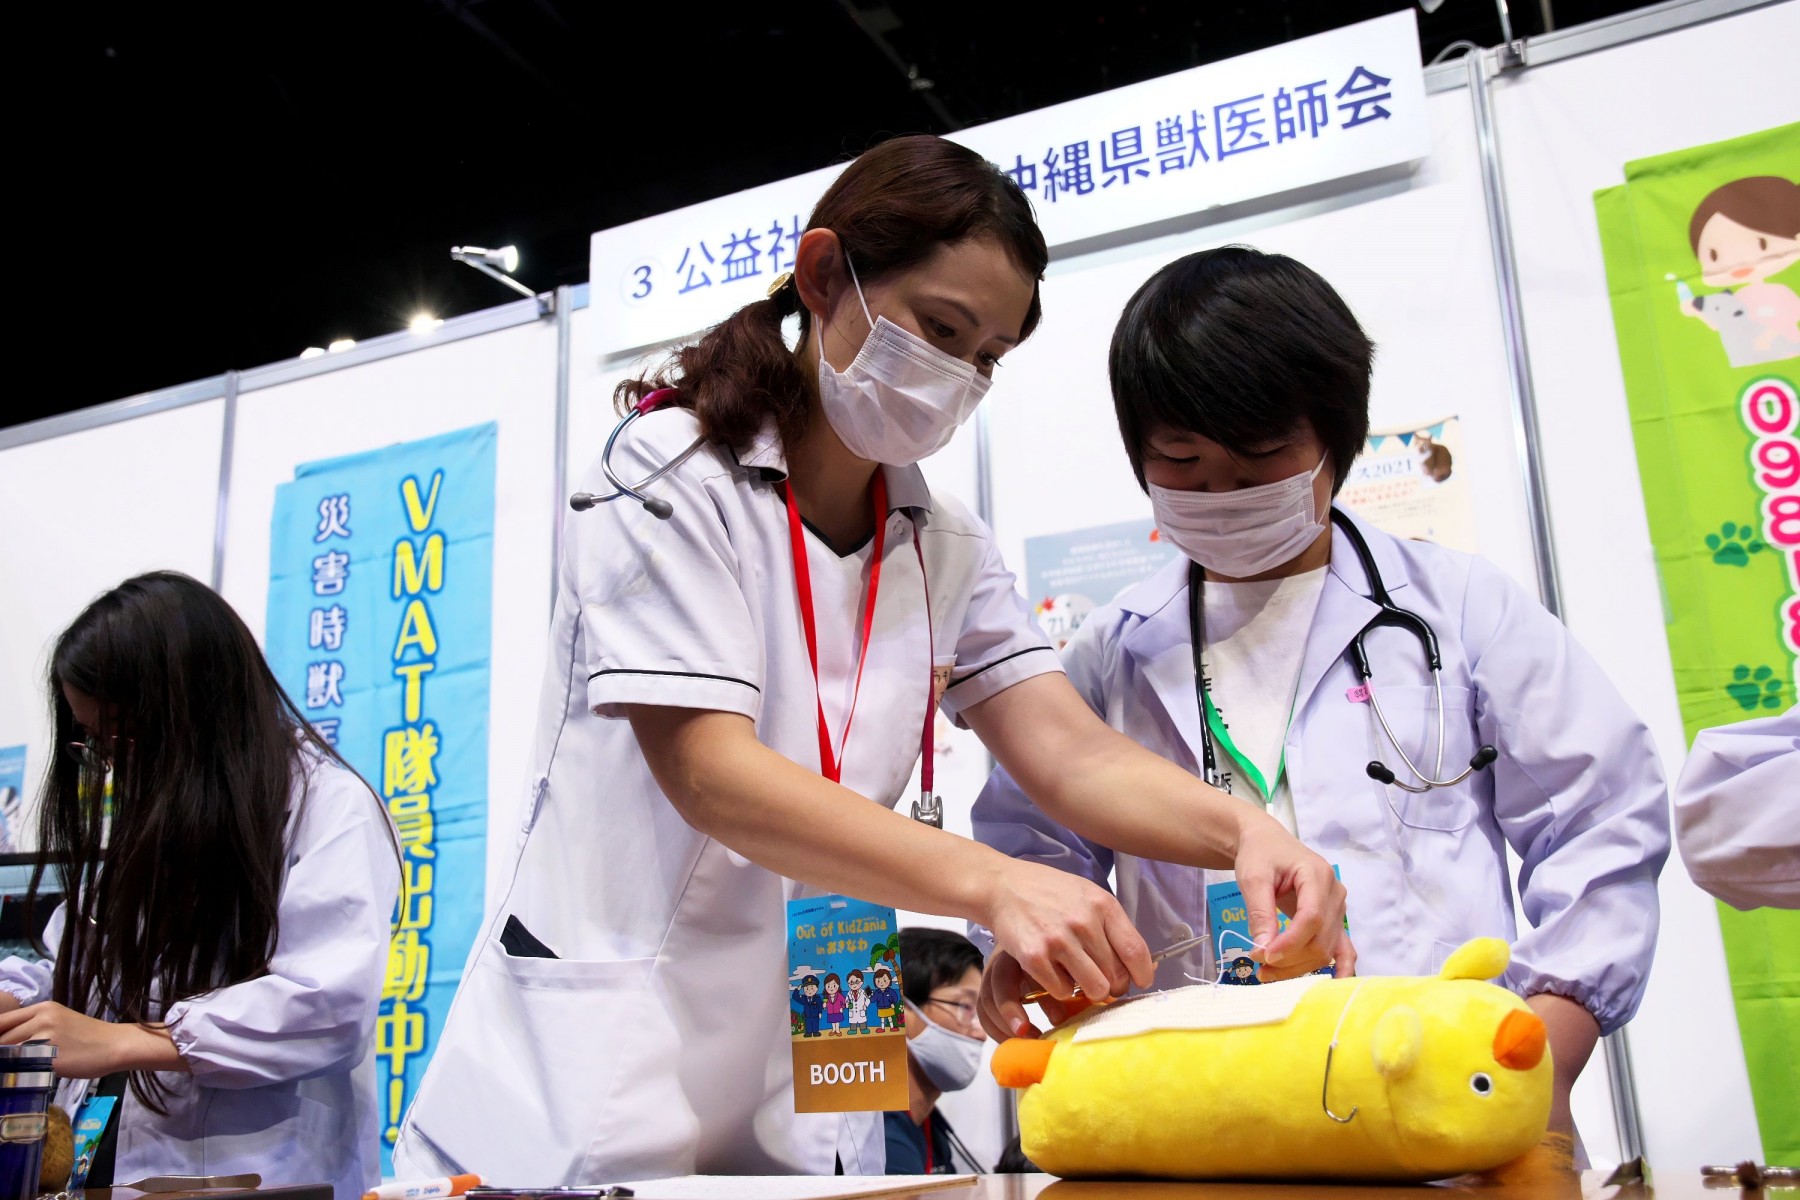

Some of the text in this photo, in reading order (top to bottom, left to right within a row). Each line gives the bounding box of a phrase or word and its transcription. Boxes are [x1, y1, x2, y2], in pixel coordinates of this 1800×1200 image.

[1748, 385, 1800, 650] 098
[1222, 906, 1247, 923] Out
[796, 918, 887, 940] Out of KidZania
[810, 1060, 886, 1085] BOOTH
